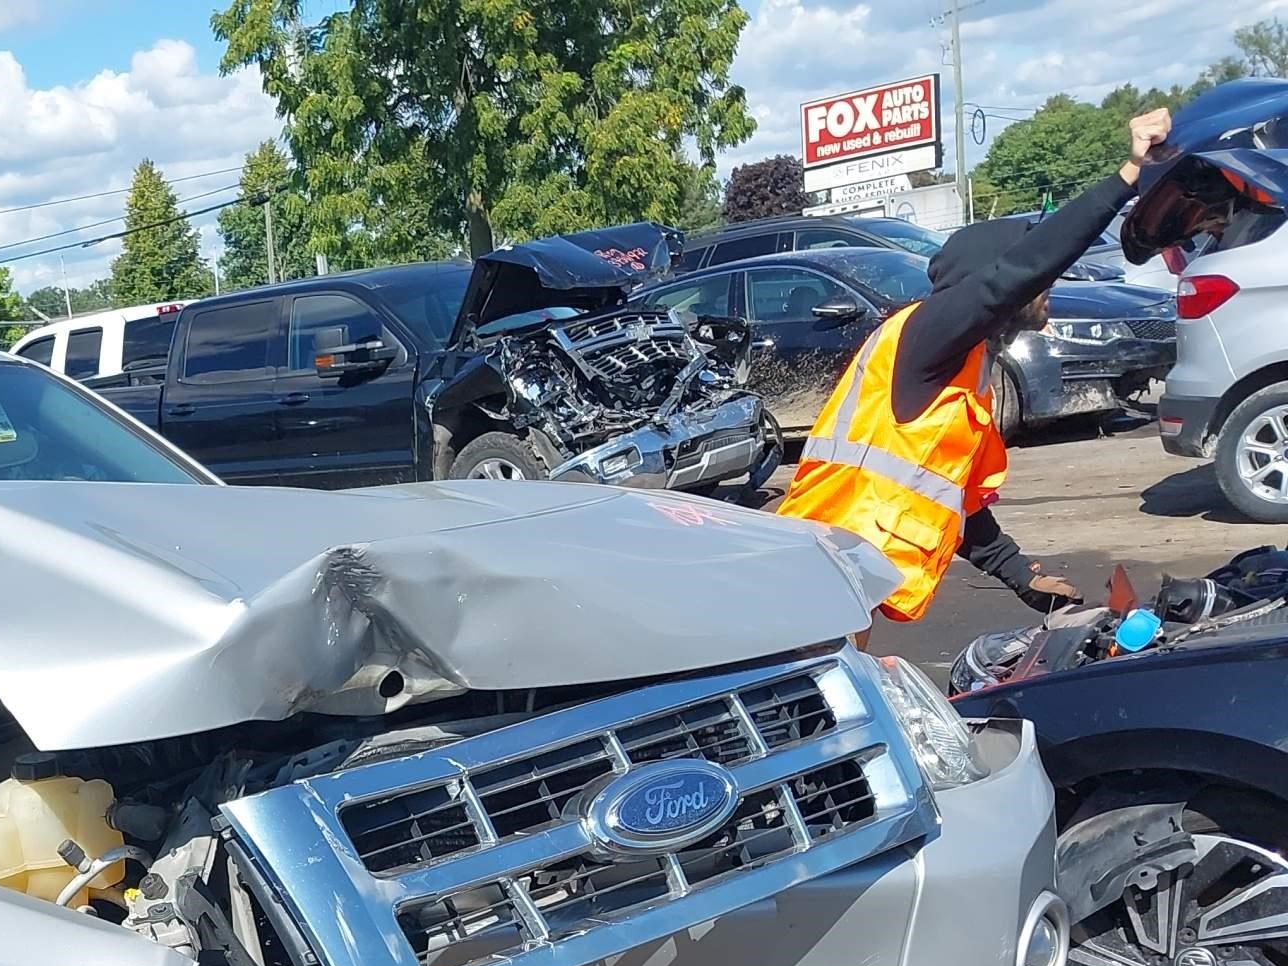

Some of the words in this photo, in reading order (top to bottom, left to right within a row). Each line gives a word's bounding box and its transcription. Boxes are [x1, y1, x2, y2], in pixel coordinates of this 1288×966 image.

[882, 84, 924, 109] AUTO
[807, 93, 881, 143] FOX
[882, 101, 929, 127] PARTS
[816, 141, 841, 158] new
[842, 133, 871, 151] used
[872, 132, 882, 145] &
[884, 124, 921, 143] rebuilt
[846, 154, 904, 176] FENIX
[842, 178, 896, 195] COMPLETE
[645, 779, 709, 825] Ford
